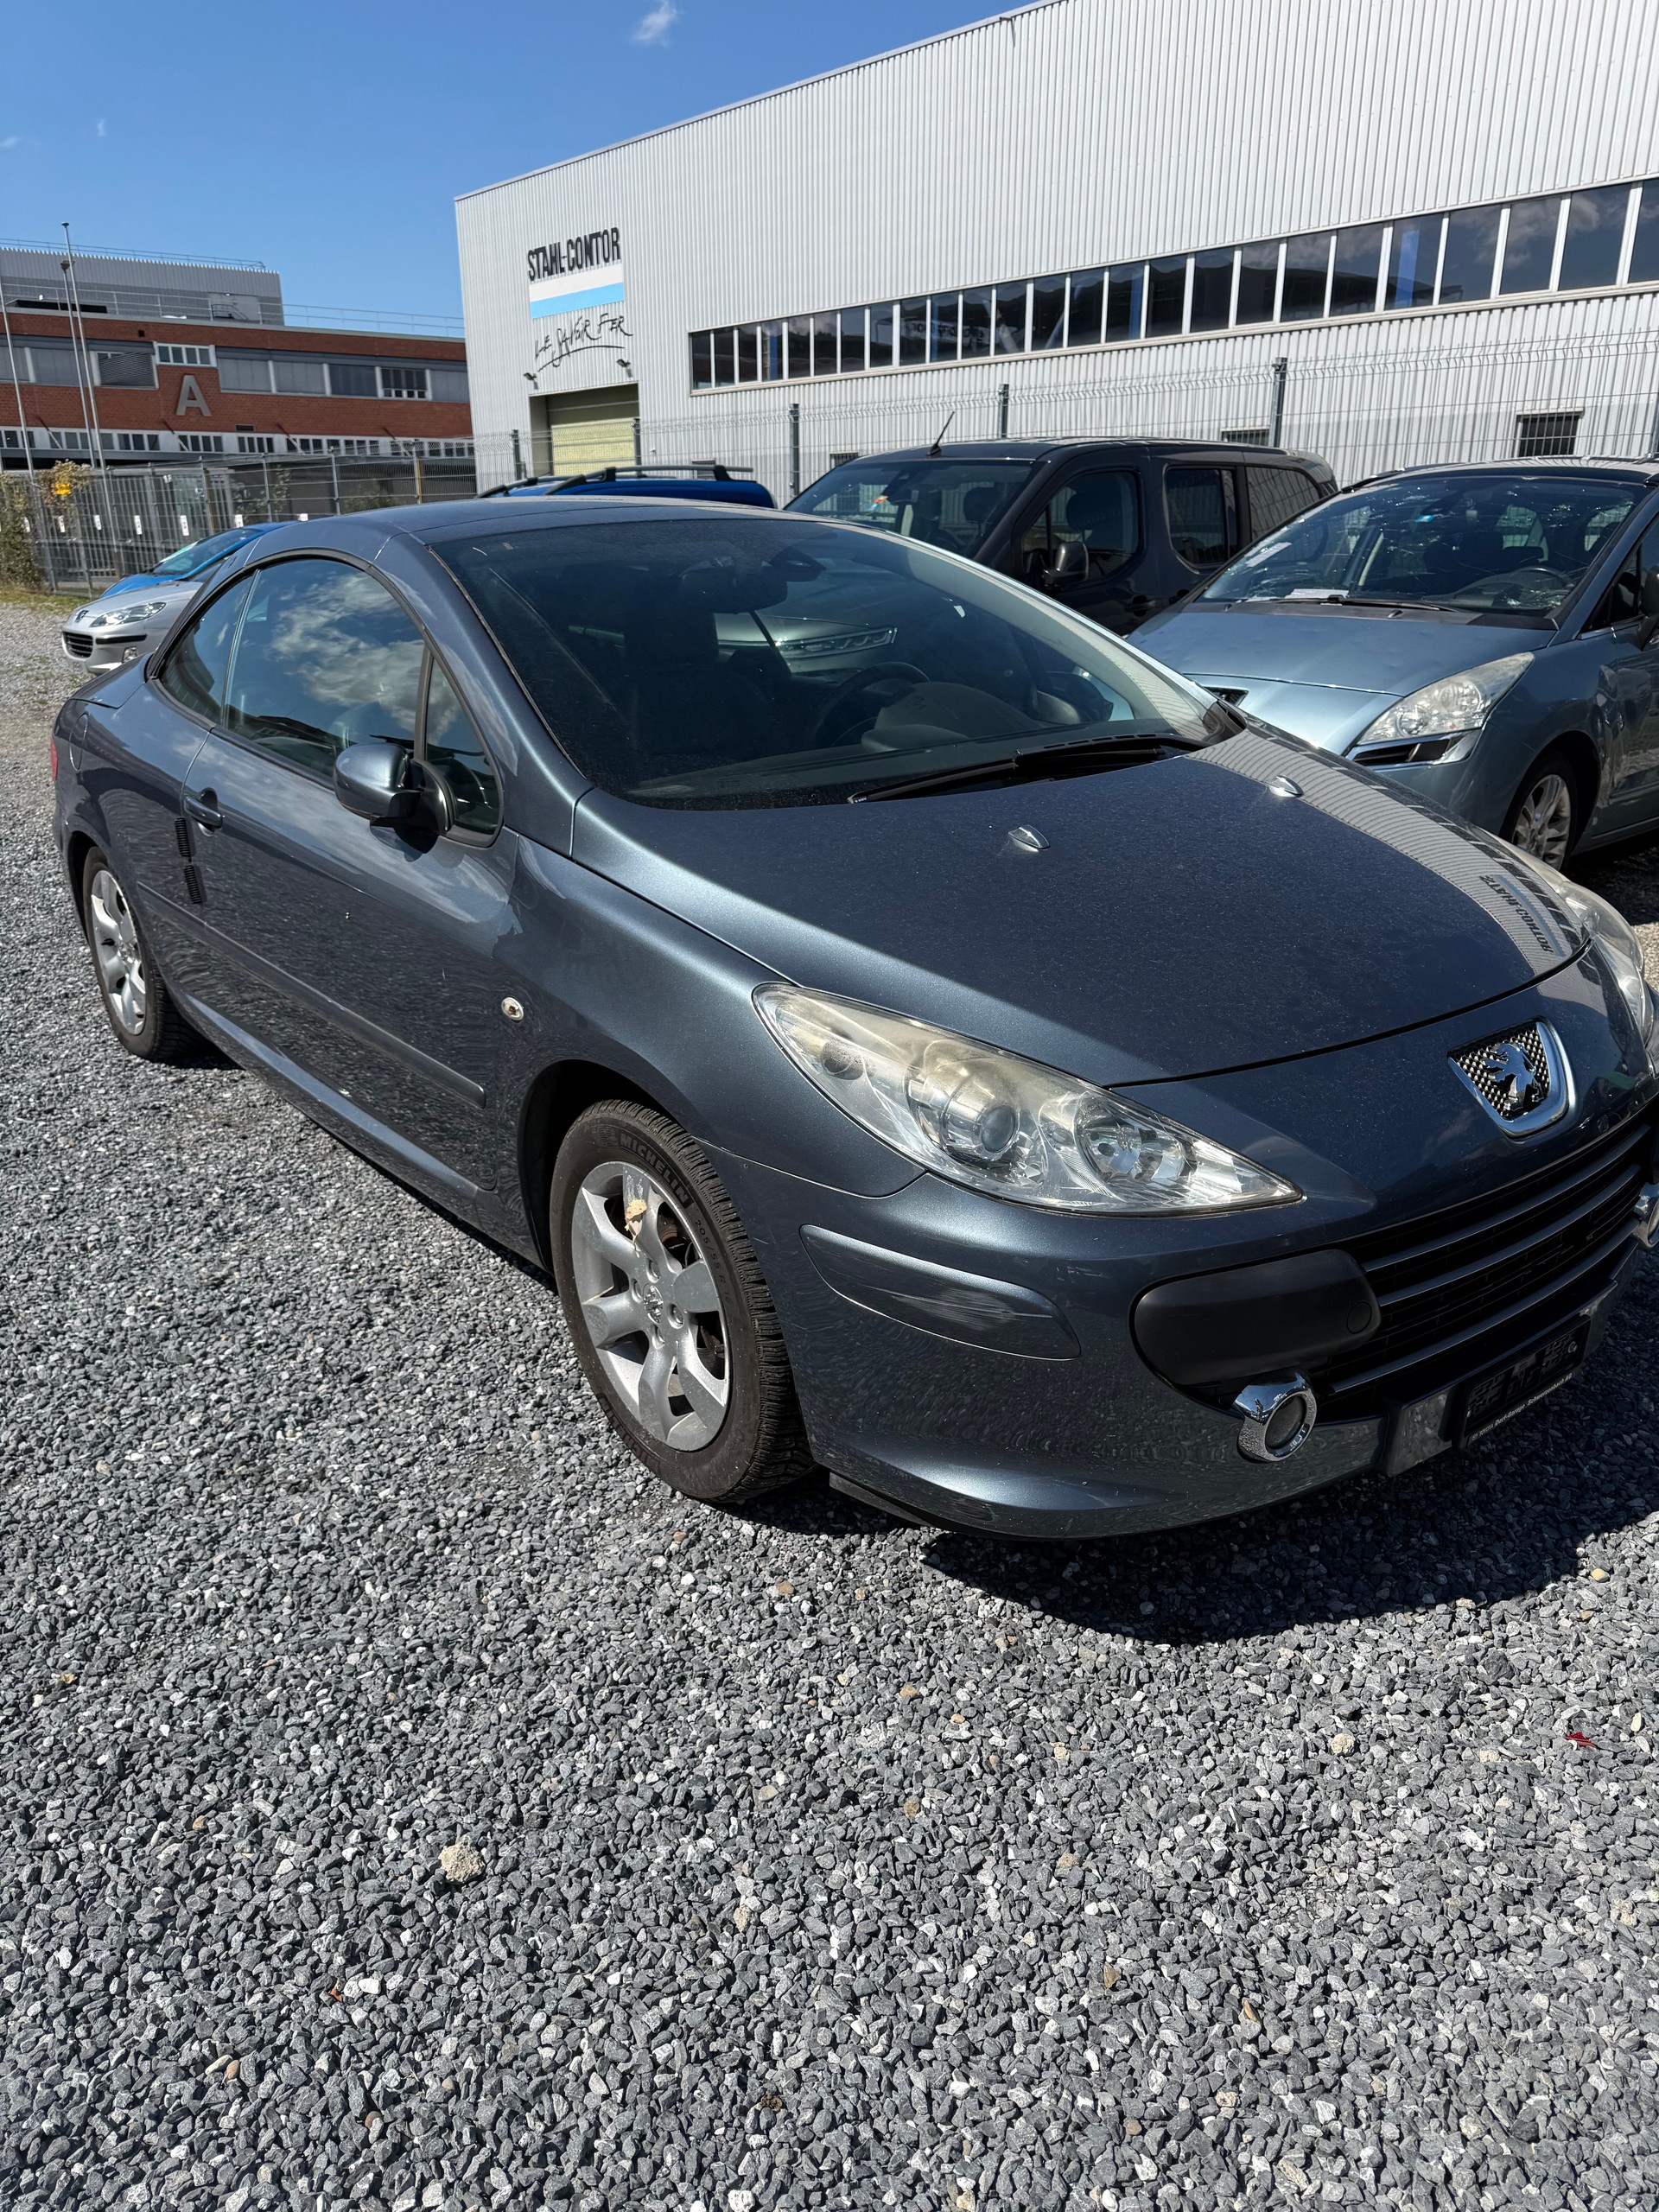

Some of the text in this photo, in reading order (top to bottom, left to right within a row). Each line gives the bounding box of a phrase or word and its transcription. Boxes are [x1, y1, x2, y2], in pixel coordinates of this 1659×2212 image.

[527, 226, 622, 282] STAHL-CONTOR
[534, 335, 553, 359] LE
[598, 312, 634, 337] FER
[175, 375, 212, 416] A
[620, 1132, 690, 1205] MICHELIN
[695, 1219, 721, 1270] 205/55
